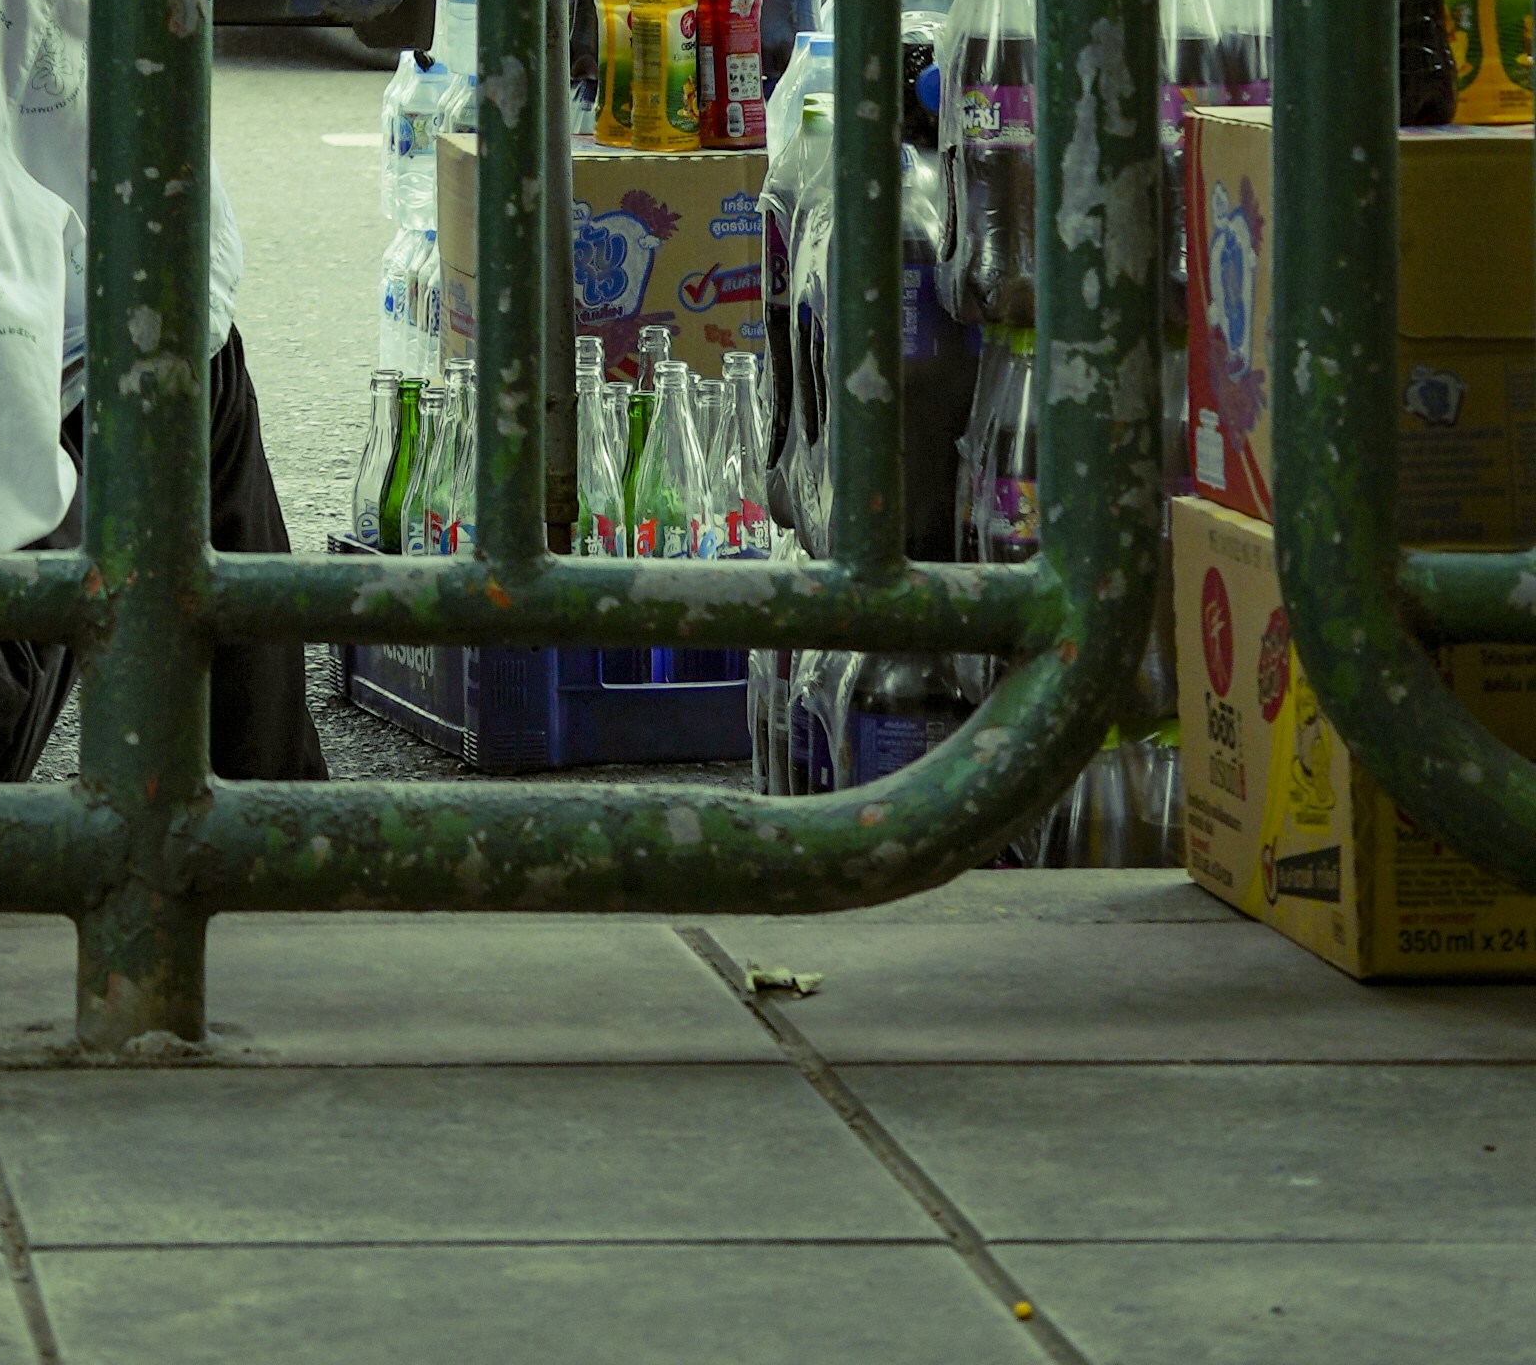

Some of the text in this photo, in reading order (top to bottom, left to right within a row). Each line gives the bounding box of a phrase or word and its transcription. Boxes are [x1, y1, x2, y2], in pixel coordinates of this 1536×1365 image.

[1398, 928, 1527, 953] 350 ml x 24
